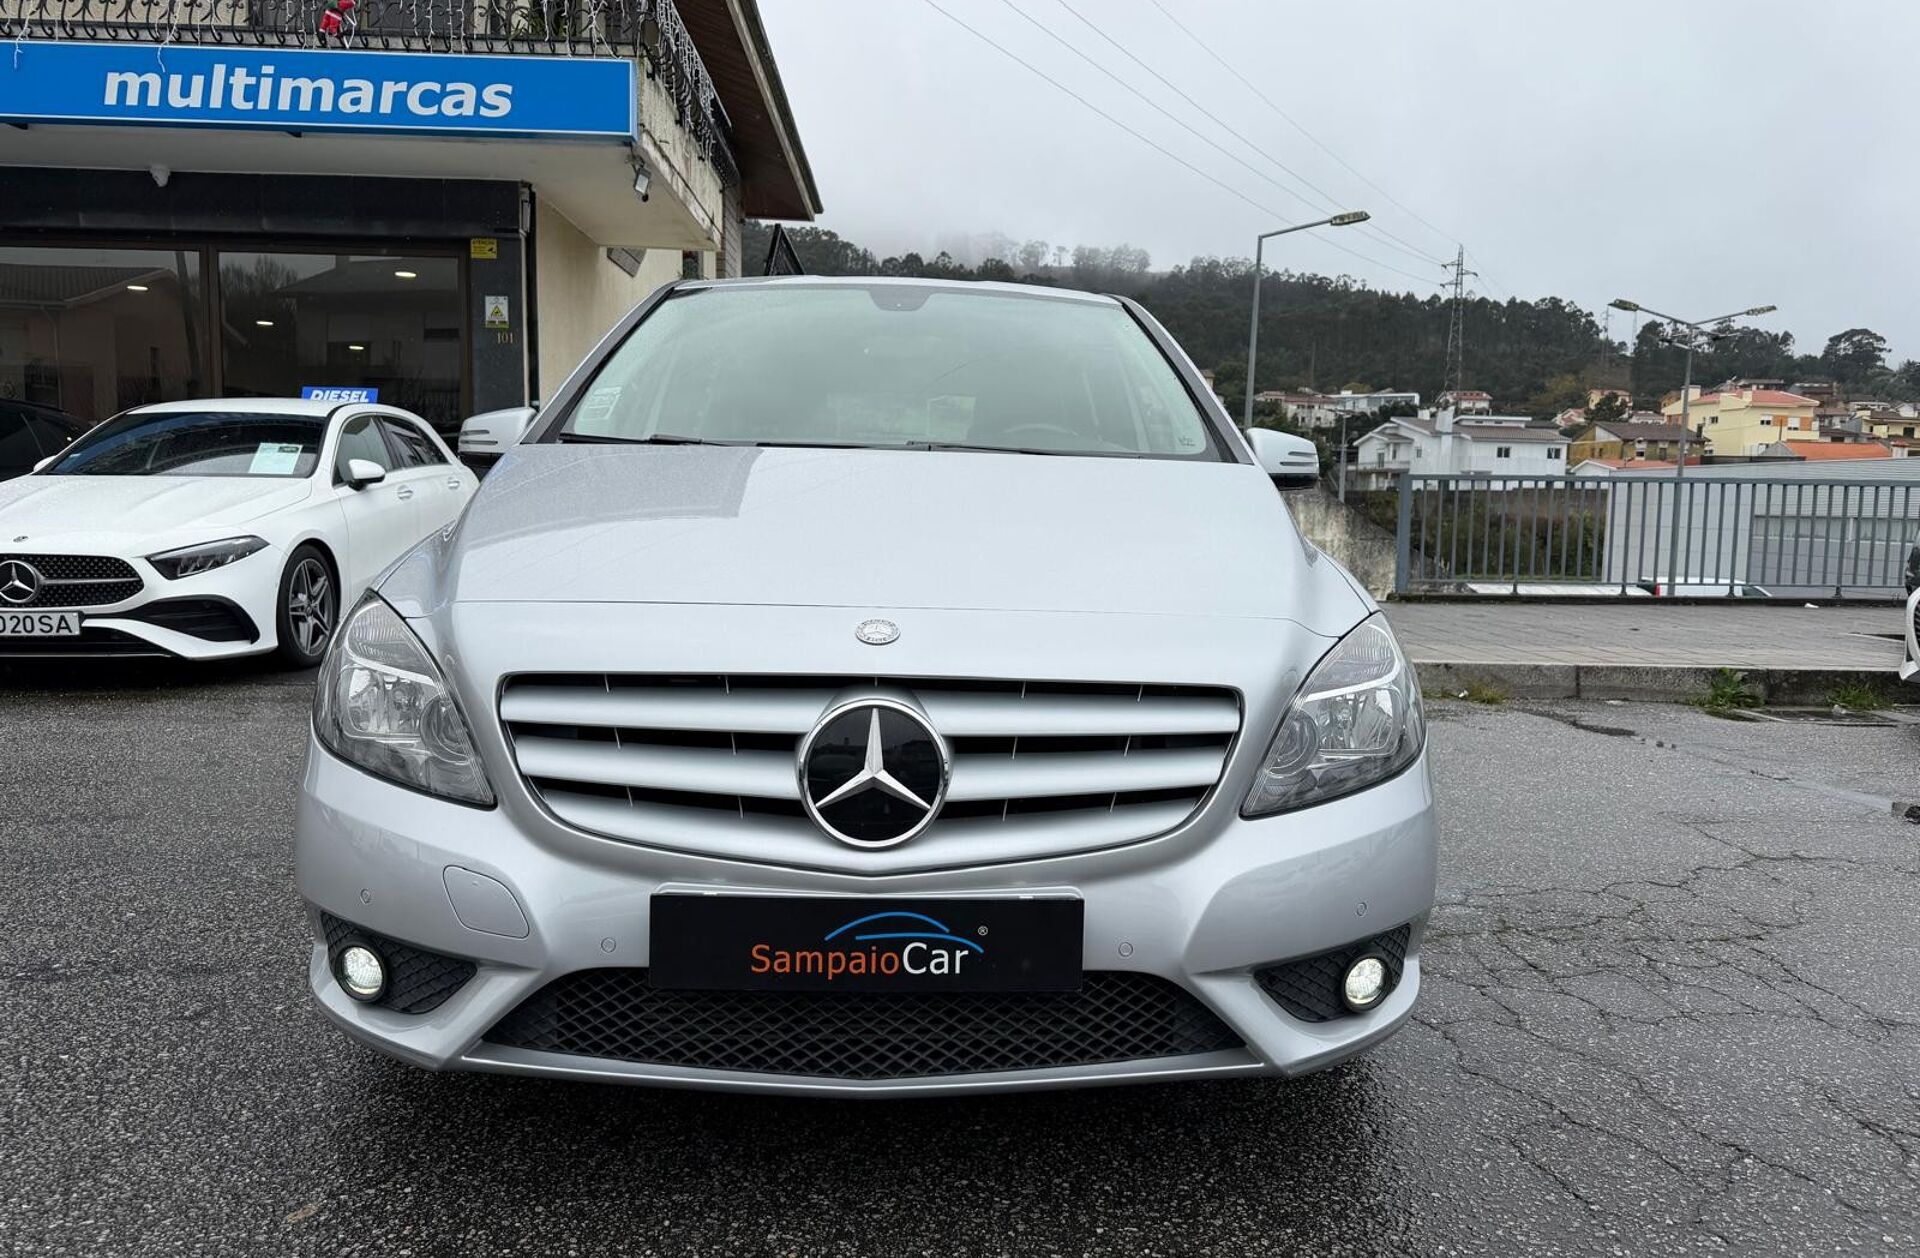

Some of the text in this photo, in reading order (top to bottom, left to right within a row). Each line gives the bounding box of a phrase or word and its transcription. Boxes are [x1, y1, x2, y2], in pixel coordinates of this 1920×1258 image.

[103, 63, 513, 118] multimarcas
[310, 388, 370, 403] DIESEL
[750, 941, 970, 981] SampaioCar
